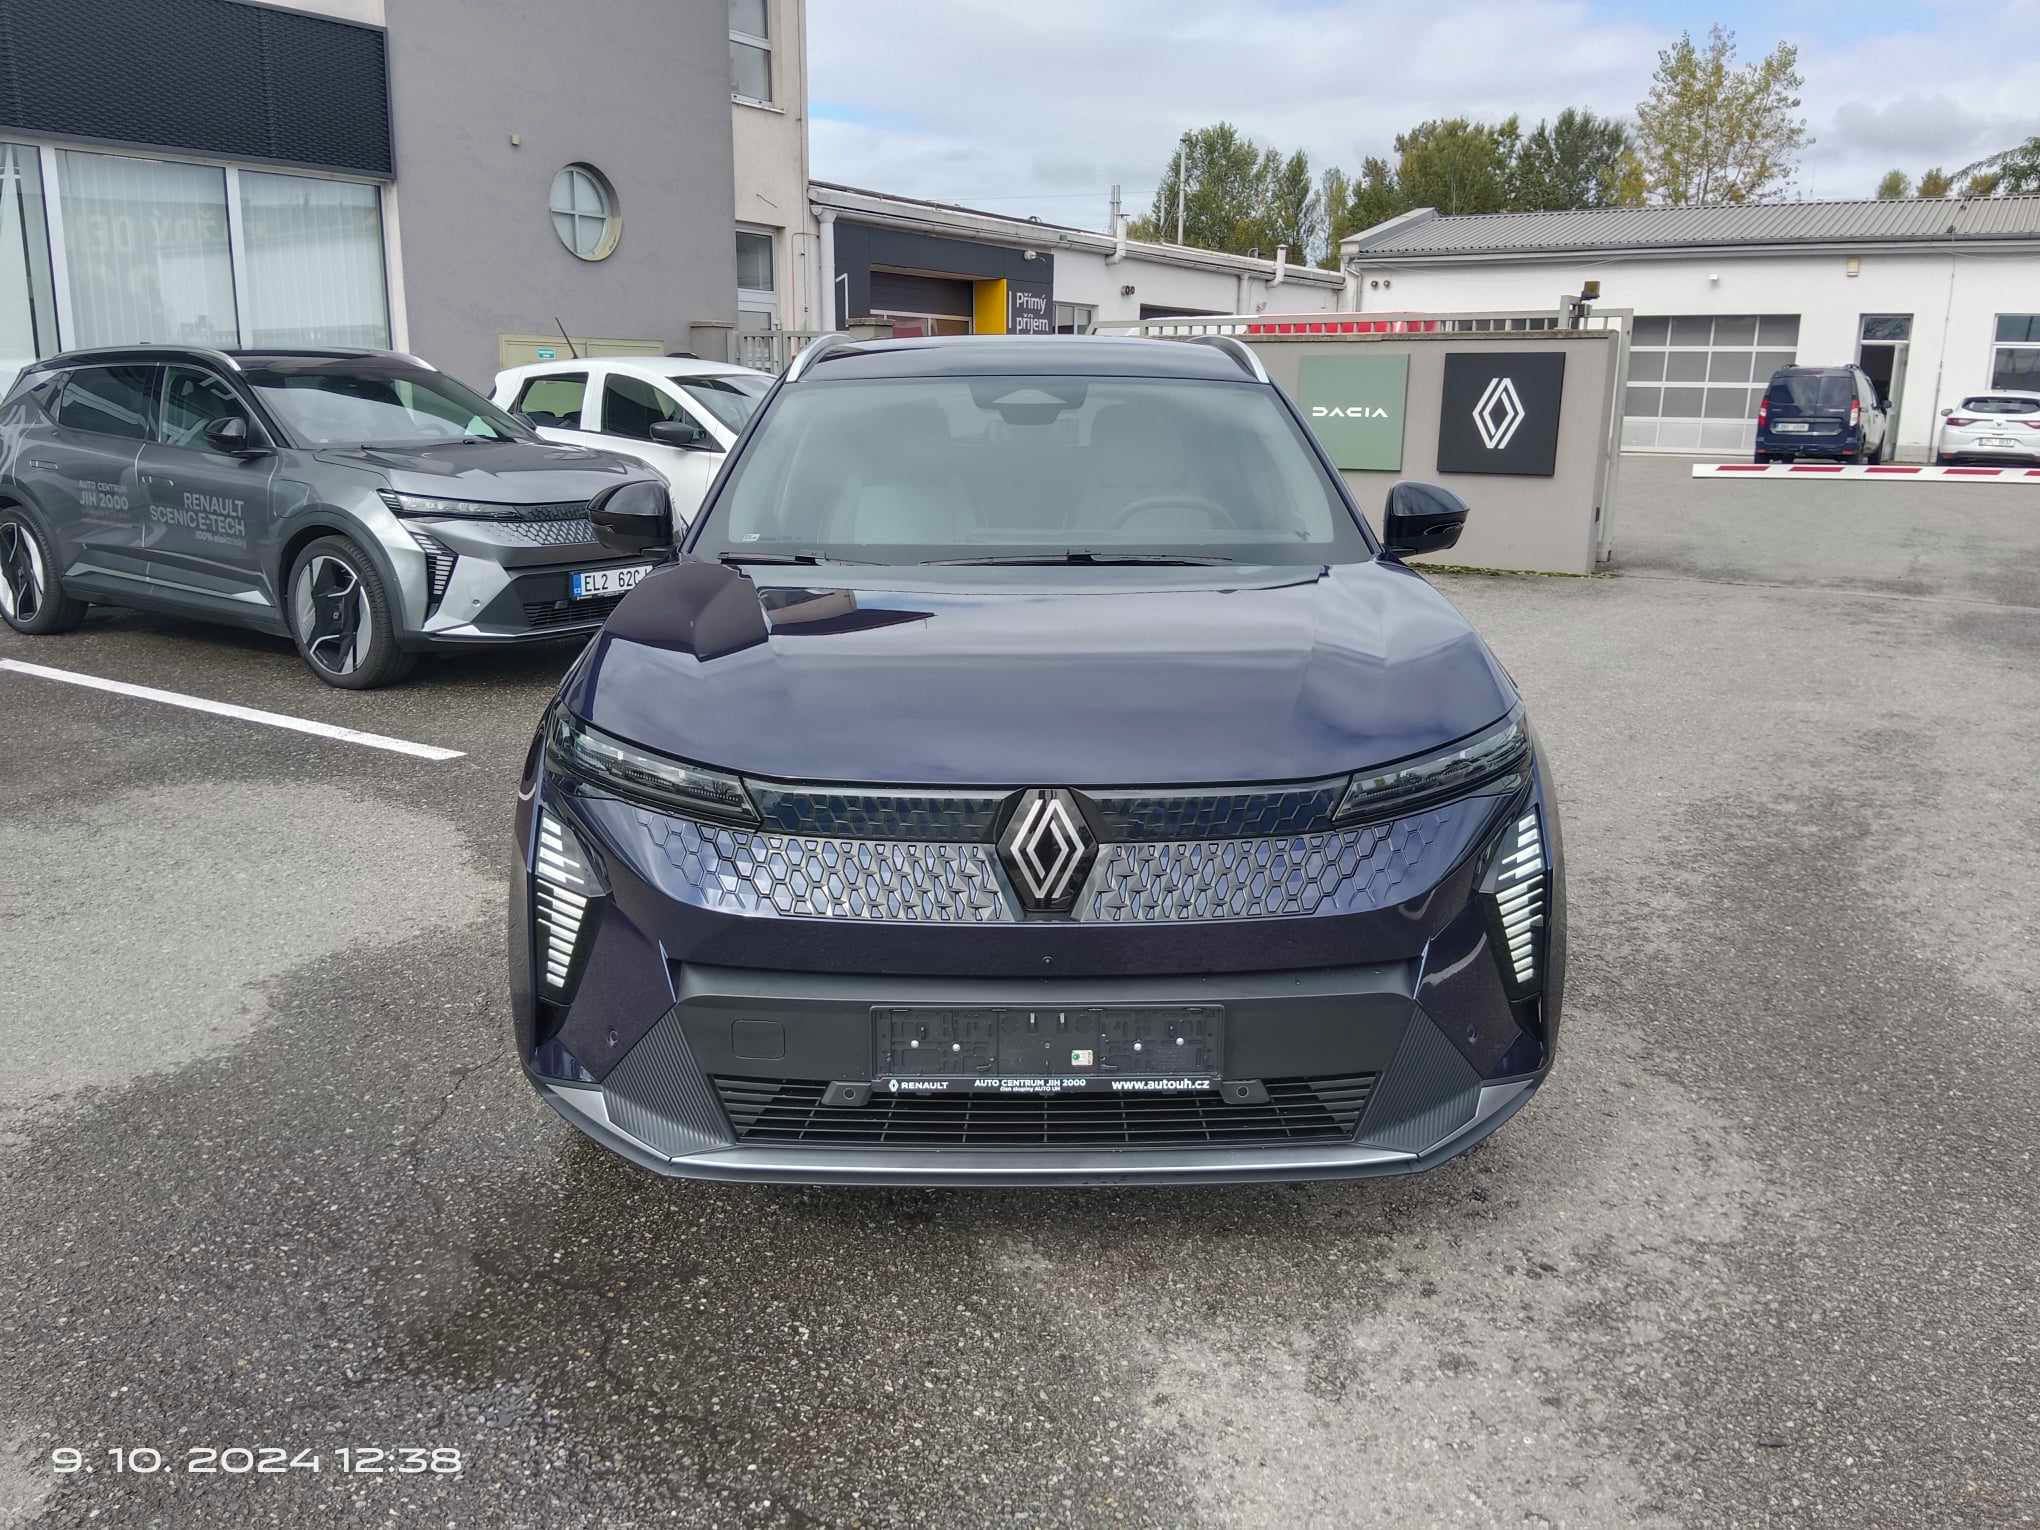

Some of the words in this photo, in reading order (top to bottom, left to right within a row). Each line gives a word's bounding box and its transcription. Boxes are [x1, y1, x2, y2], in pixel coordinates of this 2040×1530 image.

[1016, 292, 1047, 315] Přímý
[1016, 313, 1049, 334] příjem
[1312, 406, 1389, 418] DACIA
[79, 491, 97, 506] JIH
[100, 495, 129, 512] 2000
[184, 492, 245, 518] RENAULT
[150, 505, 196, 528] SCENIC
[199, 513, 245, 536] E-TECH
[584, 574, 608, 592] EL2
[618, 569, 648, 588] 62C
[901, 1081, 949, 1090] RENAULT
[974, 1079, 1000, 1088] AUTO
[1001, 1079, 1045, 1088] CENTRUM
[1046, 1079, 1061, 1088] JIH
[1062, 1079, 1086, 1087] 2000
[1111, 1079, 1210, 1090] www.autouh.cz
